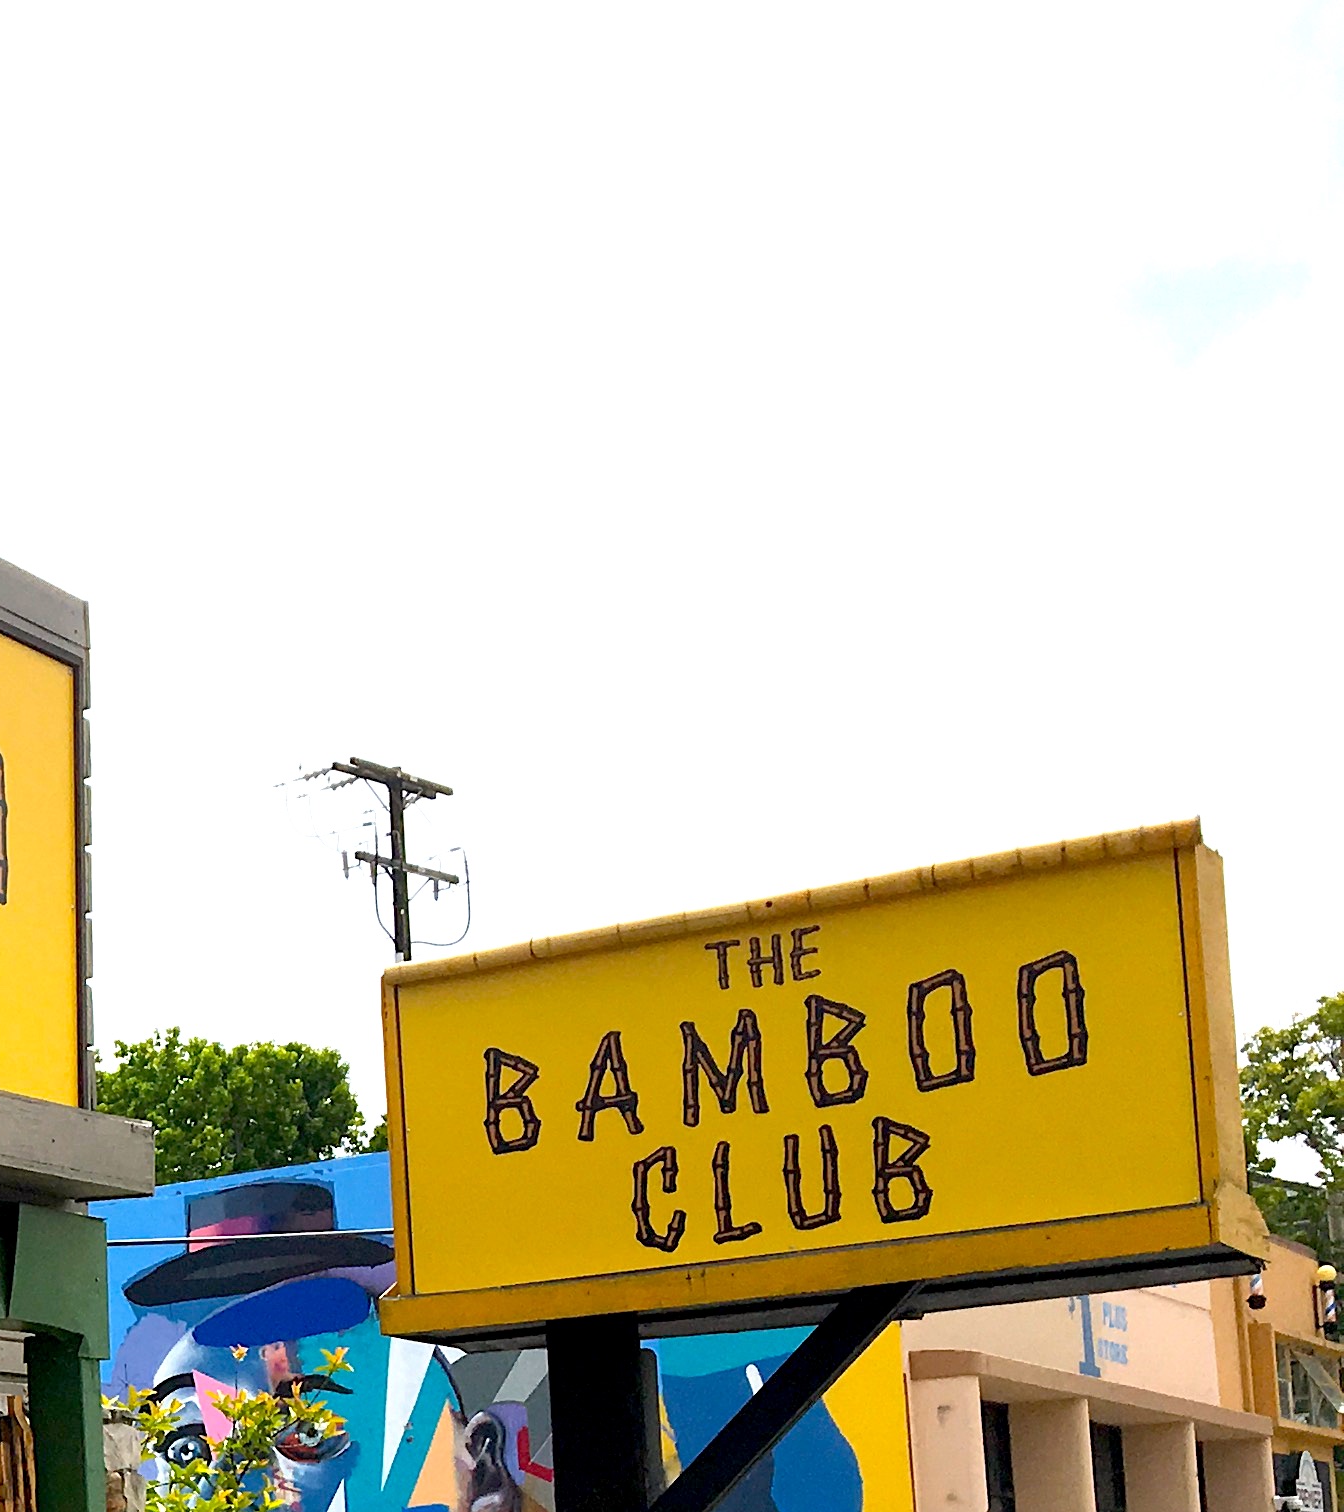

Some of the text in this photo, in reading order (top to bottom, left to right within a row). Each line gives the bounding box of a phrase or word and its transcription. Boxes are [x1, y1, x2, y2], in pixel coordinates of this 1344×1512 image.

[705, 926, 820, 990] THE
[484, 950, 1088, 1154] BAMBOO
[632, 1116, 933, 1252] CLUB
